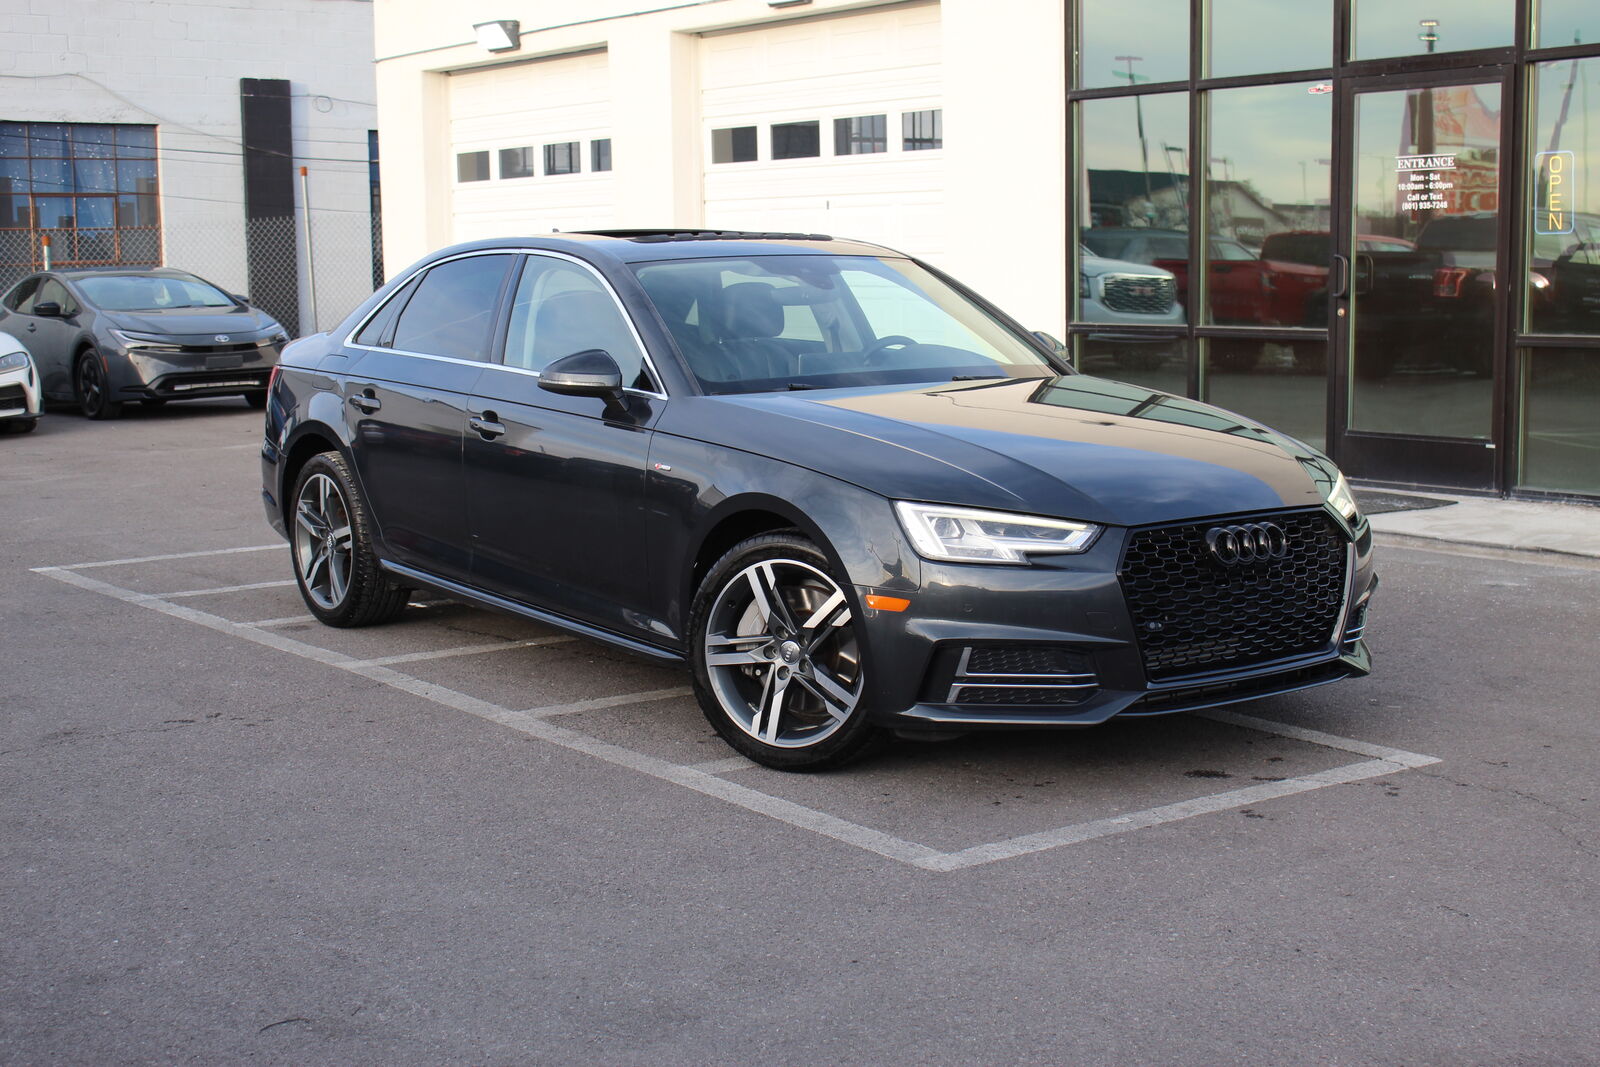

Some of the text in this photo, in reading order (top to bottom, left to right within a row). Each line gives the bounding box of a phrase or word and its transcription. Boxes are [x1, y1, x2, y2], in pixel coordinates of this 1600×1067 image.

[1397, 157, 1455, 169] ENTRANCE
[1410, 173, 1424, 181] Mon
[1429, 173, 1441, 181] Sat
[1398, 183, 1424, 191] 10:00am
[1407, 193, 1420, 201] Call
[1428, 193, 1443, 201] Text
[1548, 155, 1563, 231] OPEN
